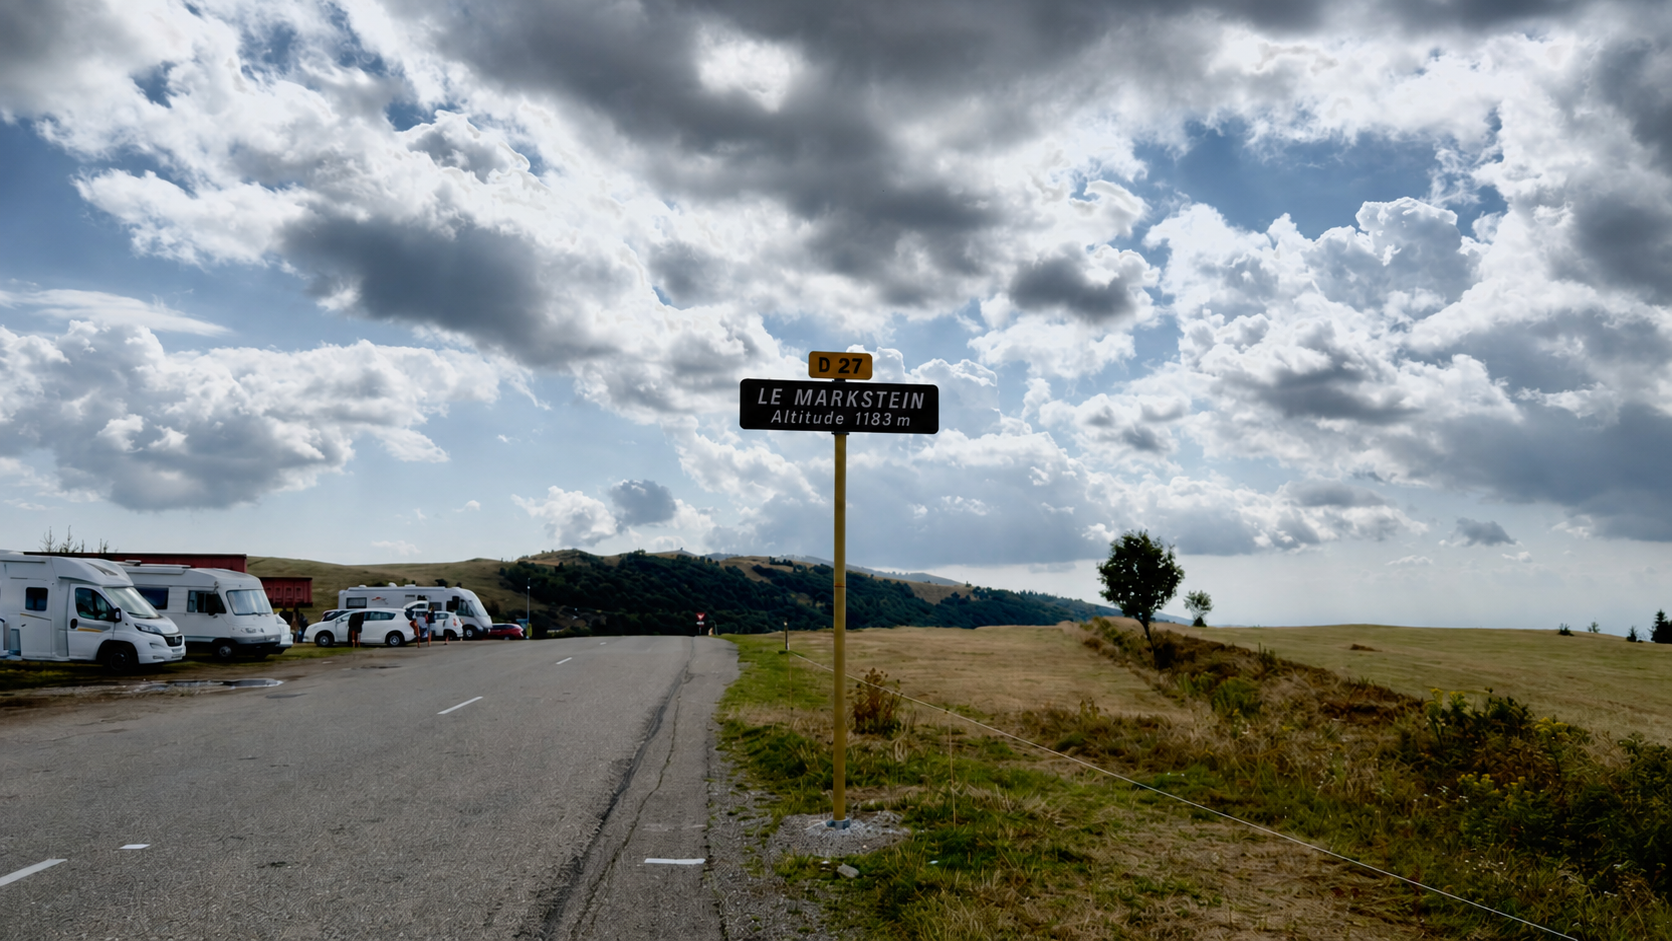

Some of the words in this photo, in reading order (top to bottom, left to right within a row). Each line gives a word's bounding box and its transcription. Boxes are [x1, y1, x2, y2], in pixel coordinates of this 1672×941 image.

[818, 357, 830, 373] D
[838, 358, 863, 374] 27
[758, 387, 783, 405] LE
[794, 389, 925, 409] MARKSTEIN
[771, 410, 844, 425] Altitude
[856, 412, 892, 426] 1183
[897, 416, 911, 427] m
